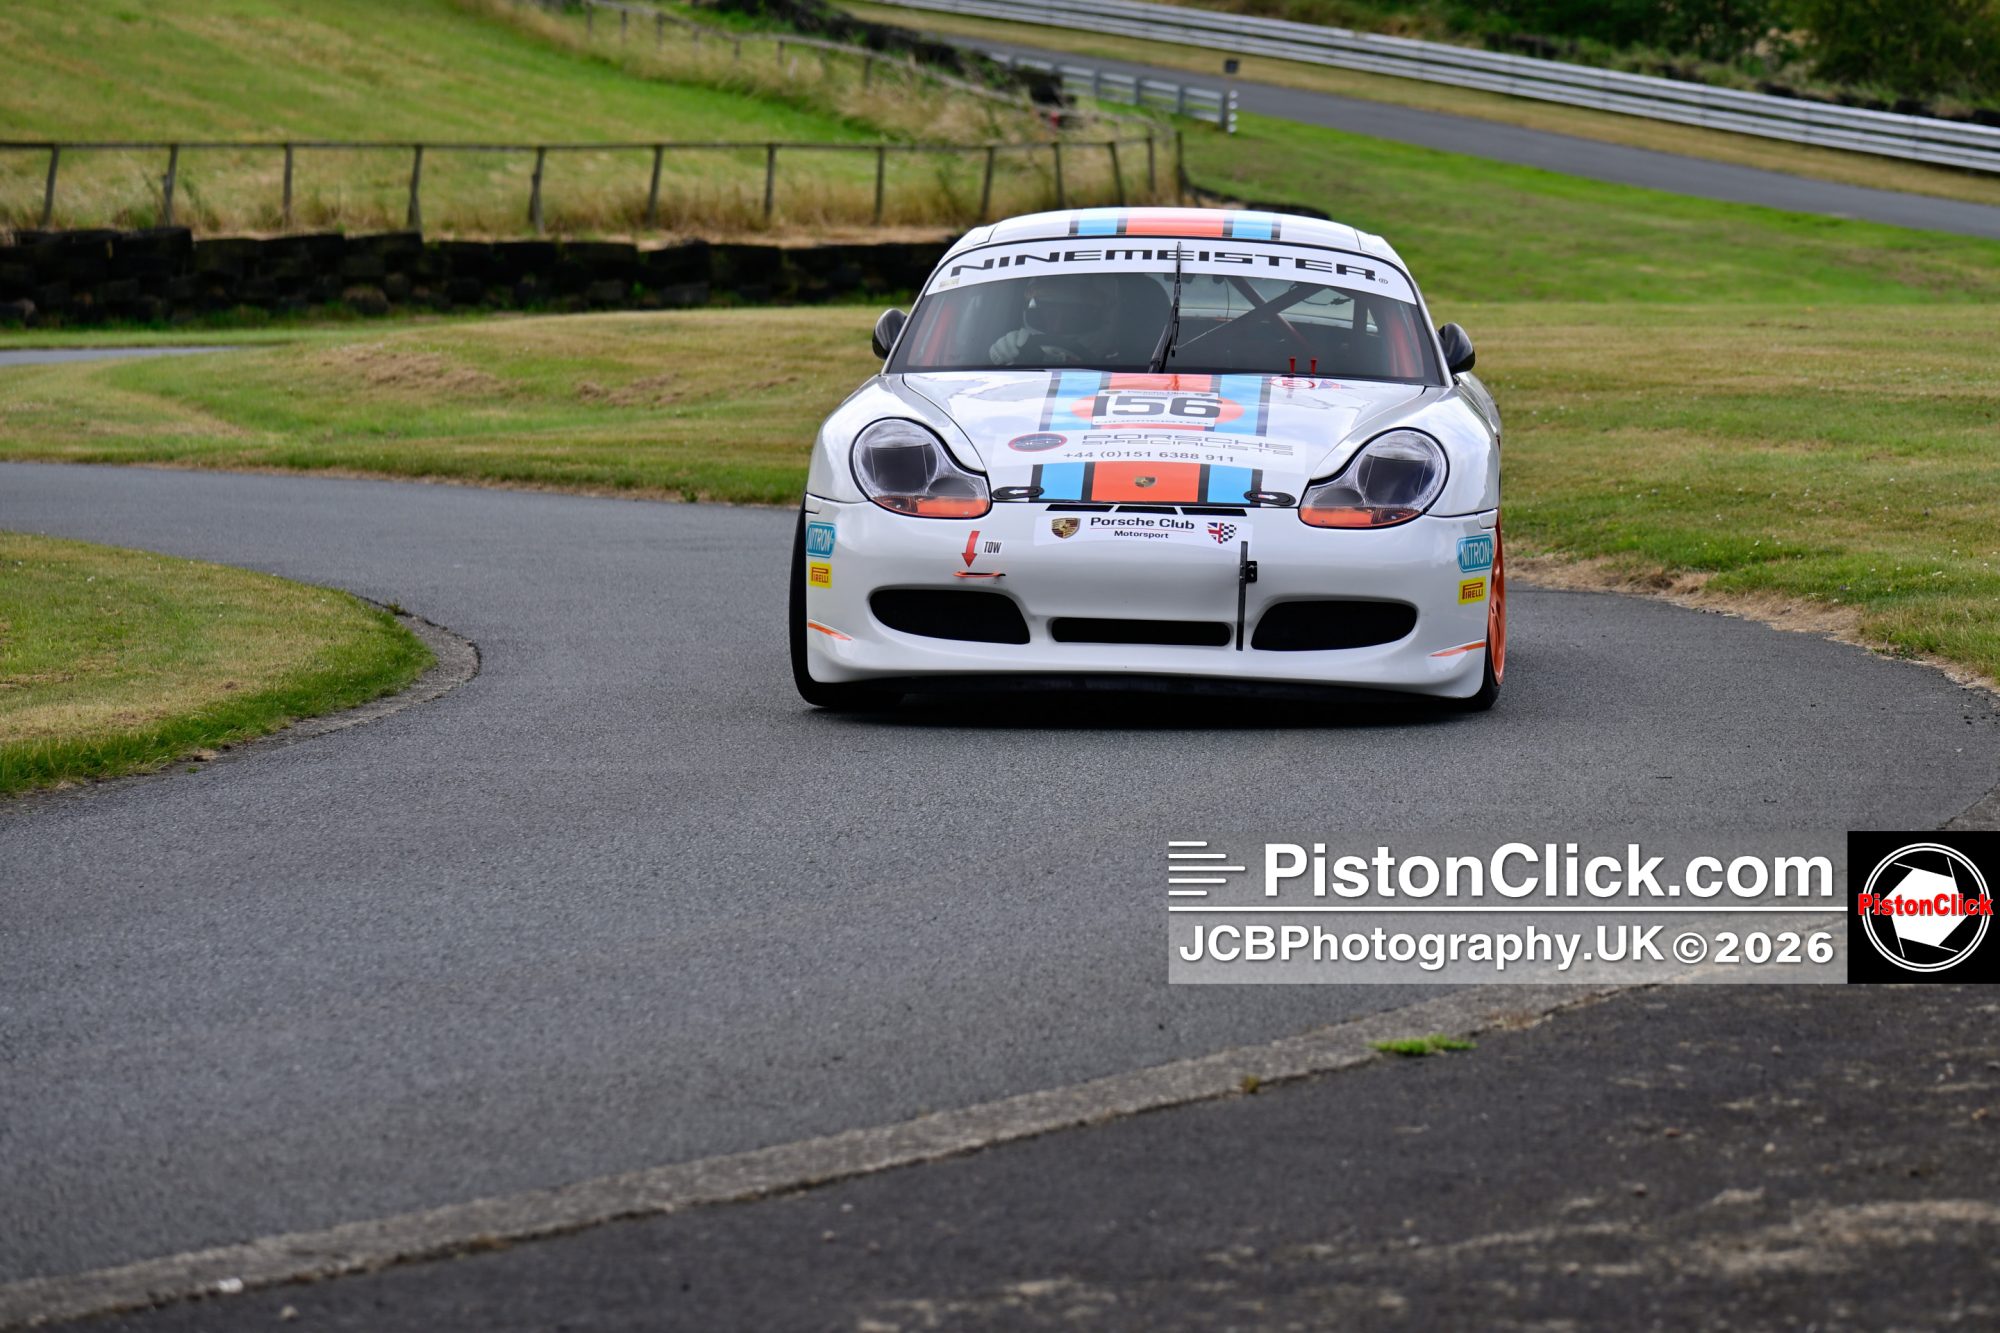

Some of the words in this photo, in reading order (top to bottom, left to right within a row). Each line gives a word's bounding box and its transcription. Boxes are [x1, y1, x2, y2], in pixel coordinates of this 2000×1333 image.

[1092, 395, 1223, 419] 156
[1081, 439, 1294, 457] SPECIALISTS
[1082, 433, 1294, 451] PORSCHE
[1100, 450, 1152, 458] (0)151
[1158, 451, 1200, 460] 6388
[1205, 454, 1235, 463] 911
[1090, 516, 1155, 527] Porsche
[1159, 518, 1196, 530] Club
[807, 527, 834, 553] NITRON
[1113, 530, 1169, 539] Motorsport
[983, 541, 1002, 554] TOW
[1460, 539, 1491, 567] NITRON
[811, 566, 829, 584] PIRELLI
[1462, 582, 1484, 600] PIRELLI
